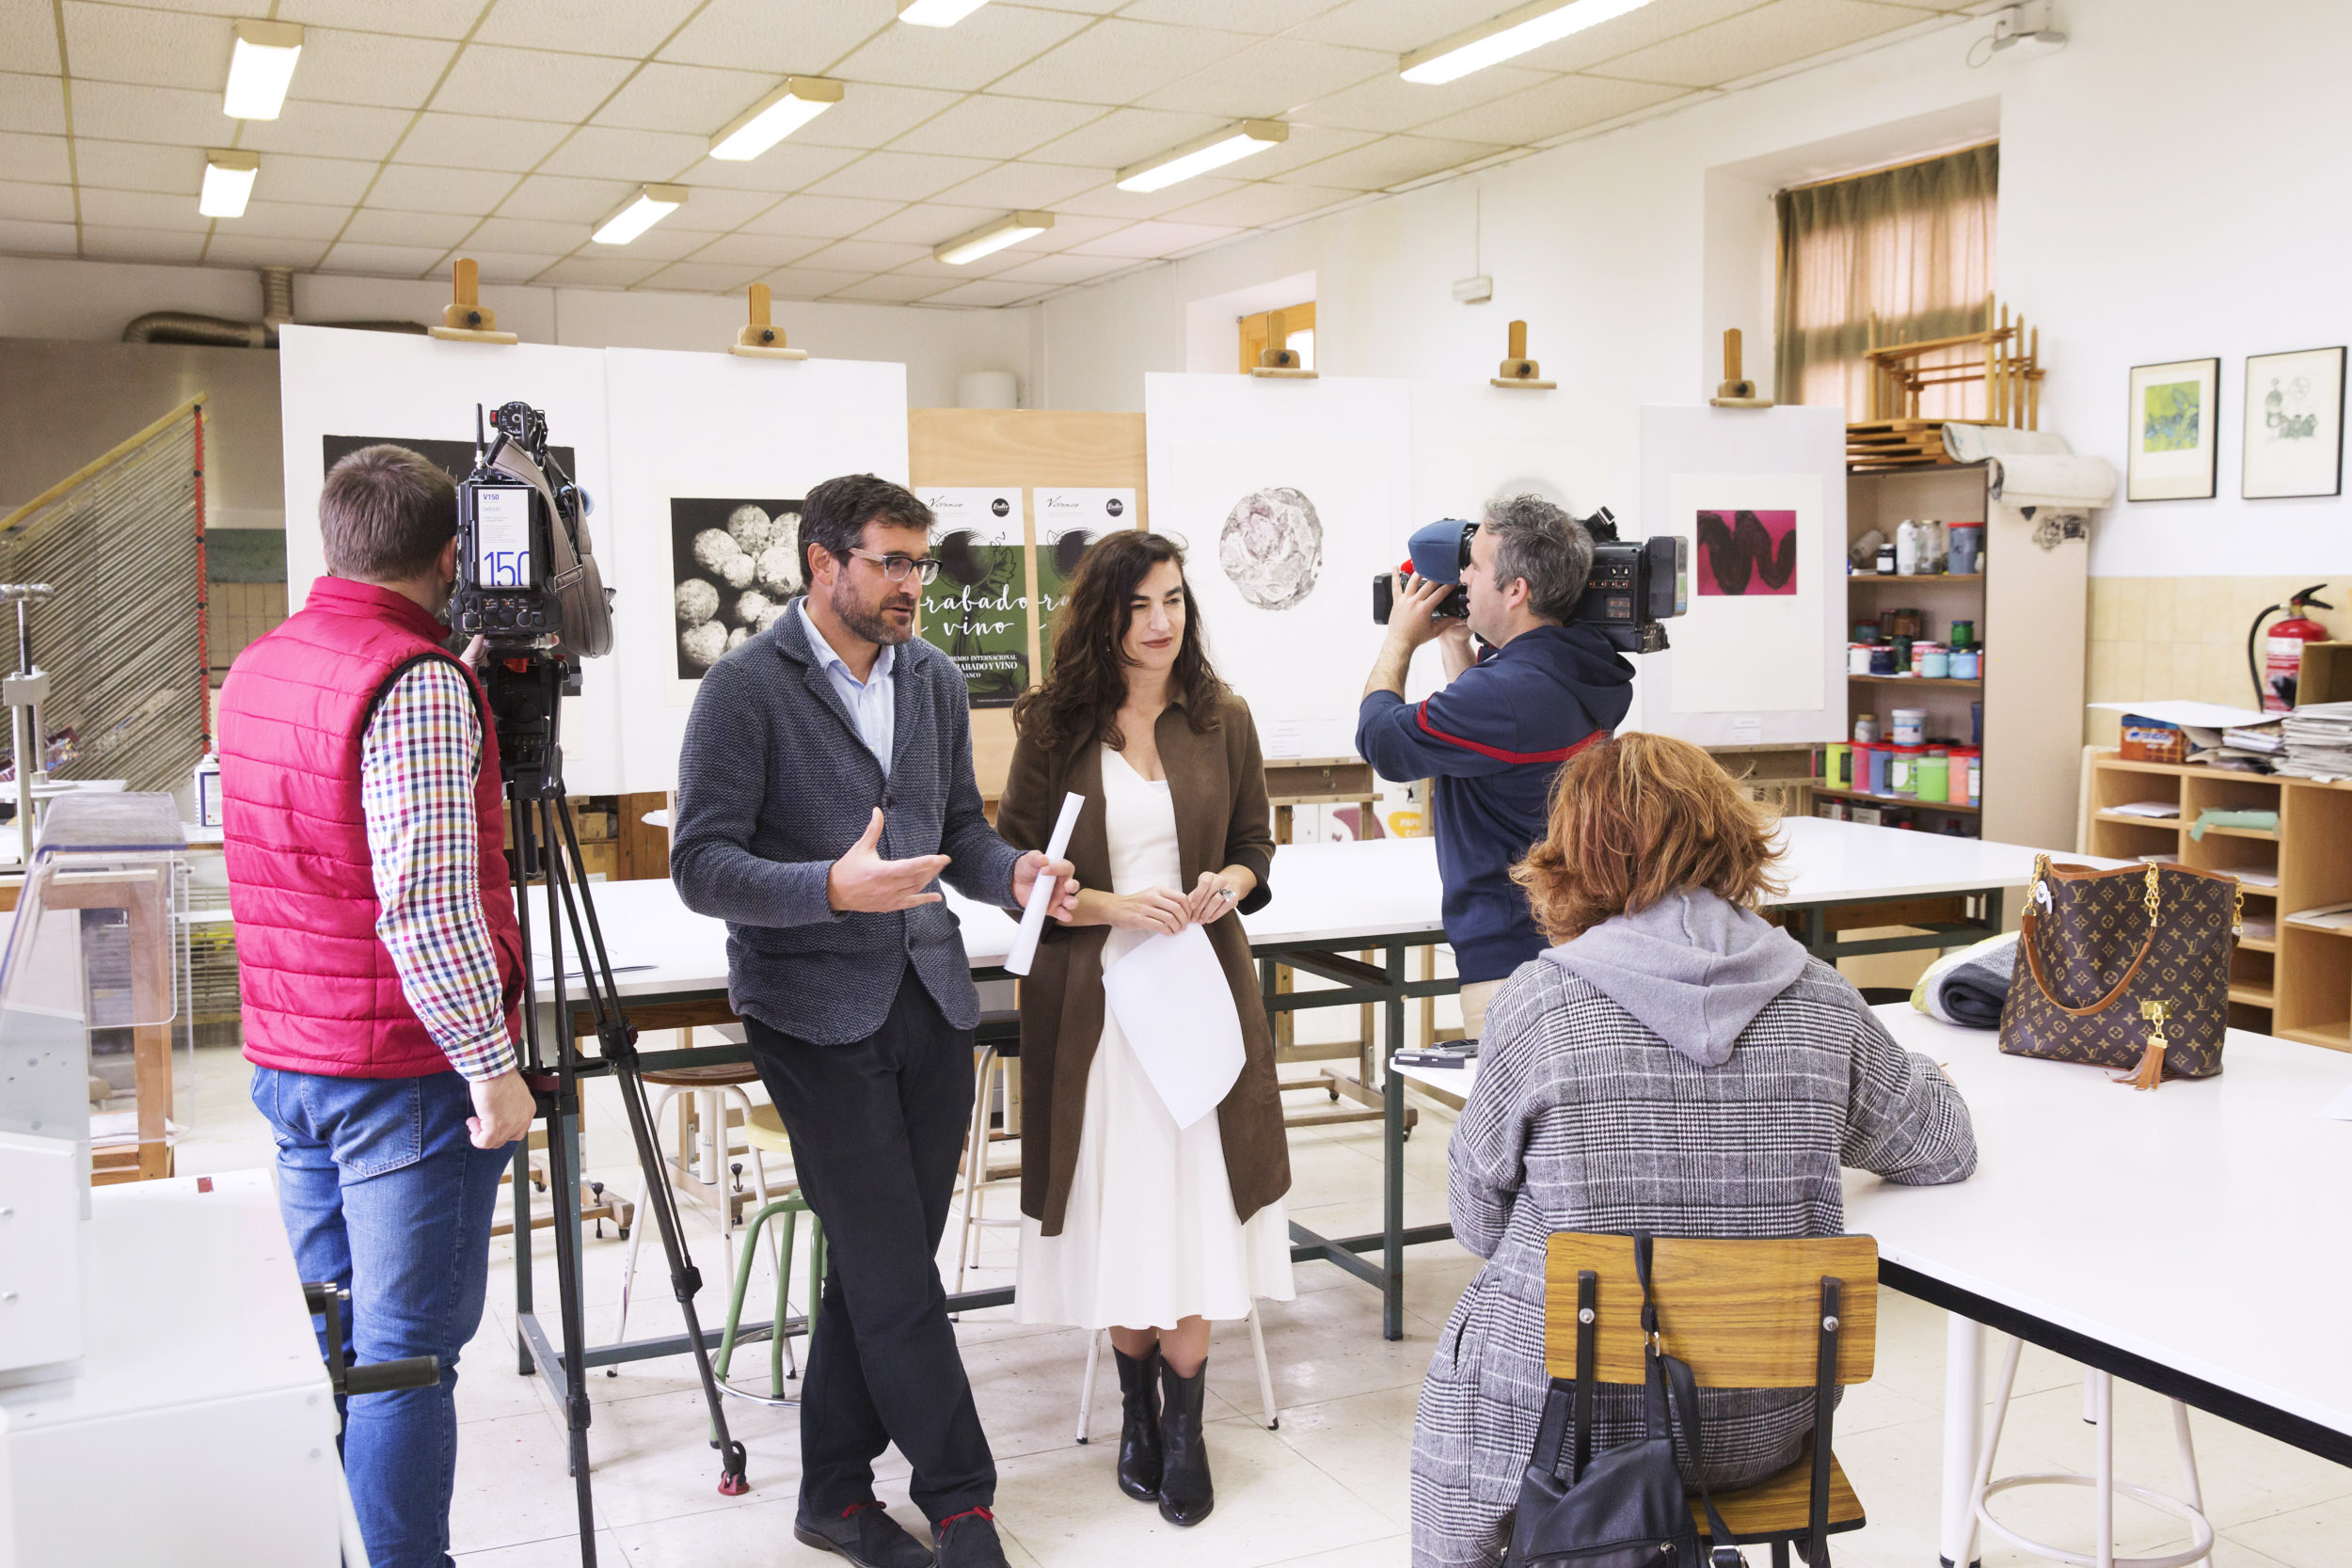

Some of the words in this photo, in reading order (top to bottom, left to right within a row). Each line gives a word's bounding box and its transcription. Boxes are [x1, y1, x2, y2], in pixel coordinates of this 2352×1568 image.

[929, 495, 963, 508] Vivanco
[1047, 495, 1080, 508] Vivanco
[943, 616, 1014, 636] vino
[995, 661, 1018, 670] VINO
